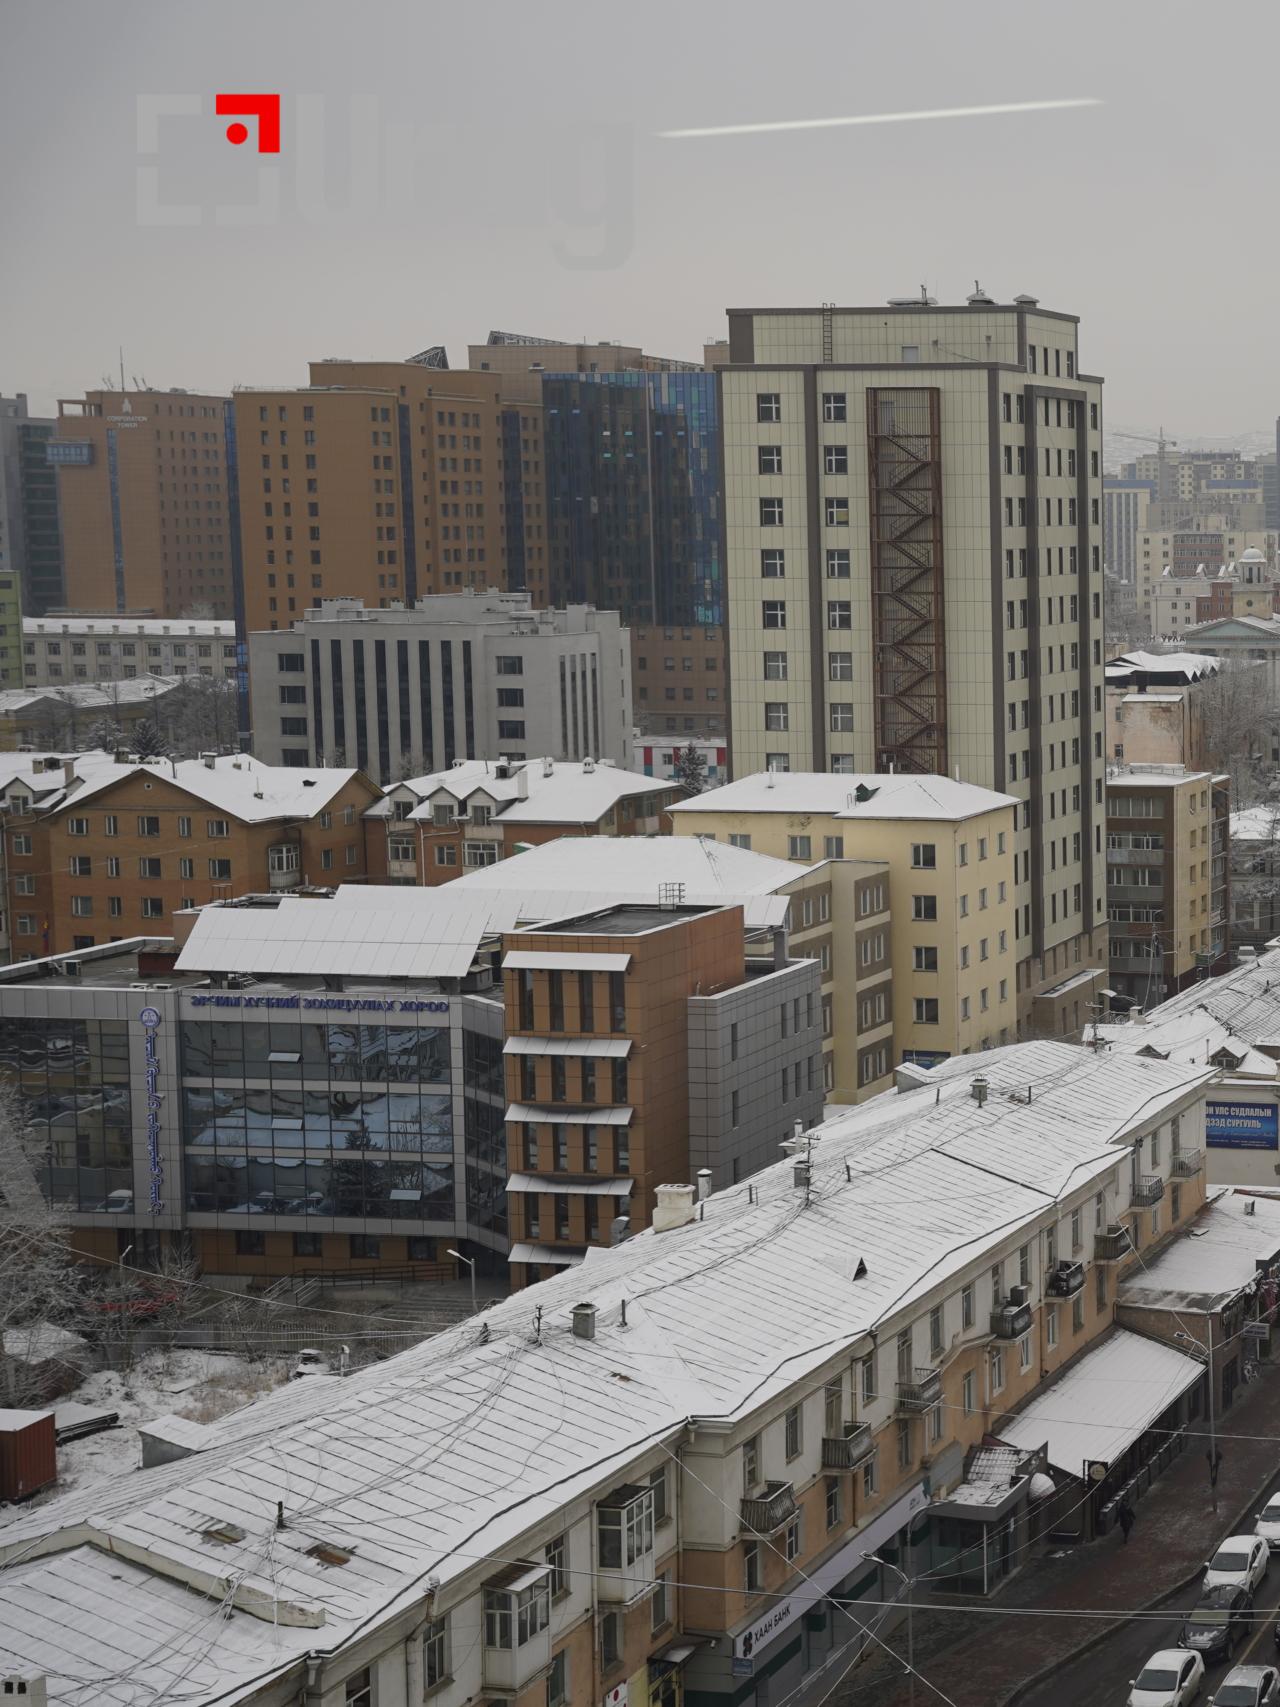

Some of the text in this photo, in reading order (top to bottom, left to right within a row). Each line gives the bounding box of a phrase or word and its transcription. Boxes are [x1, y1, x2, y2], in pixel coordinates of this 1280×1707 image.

[399, 1000, 449, 1013] ХОРОО
[1215, 1106, 1229, 1115] УЛС
[1230, 1107, 1272, 1118] СУДЛАЛЫН
[1226, 1119, 1262, 1129] СУРГУУЛЬ
[754, 1602, 791, 1645] ХААН БАНК
